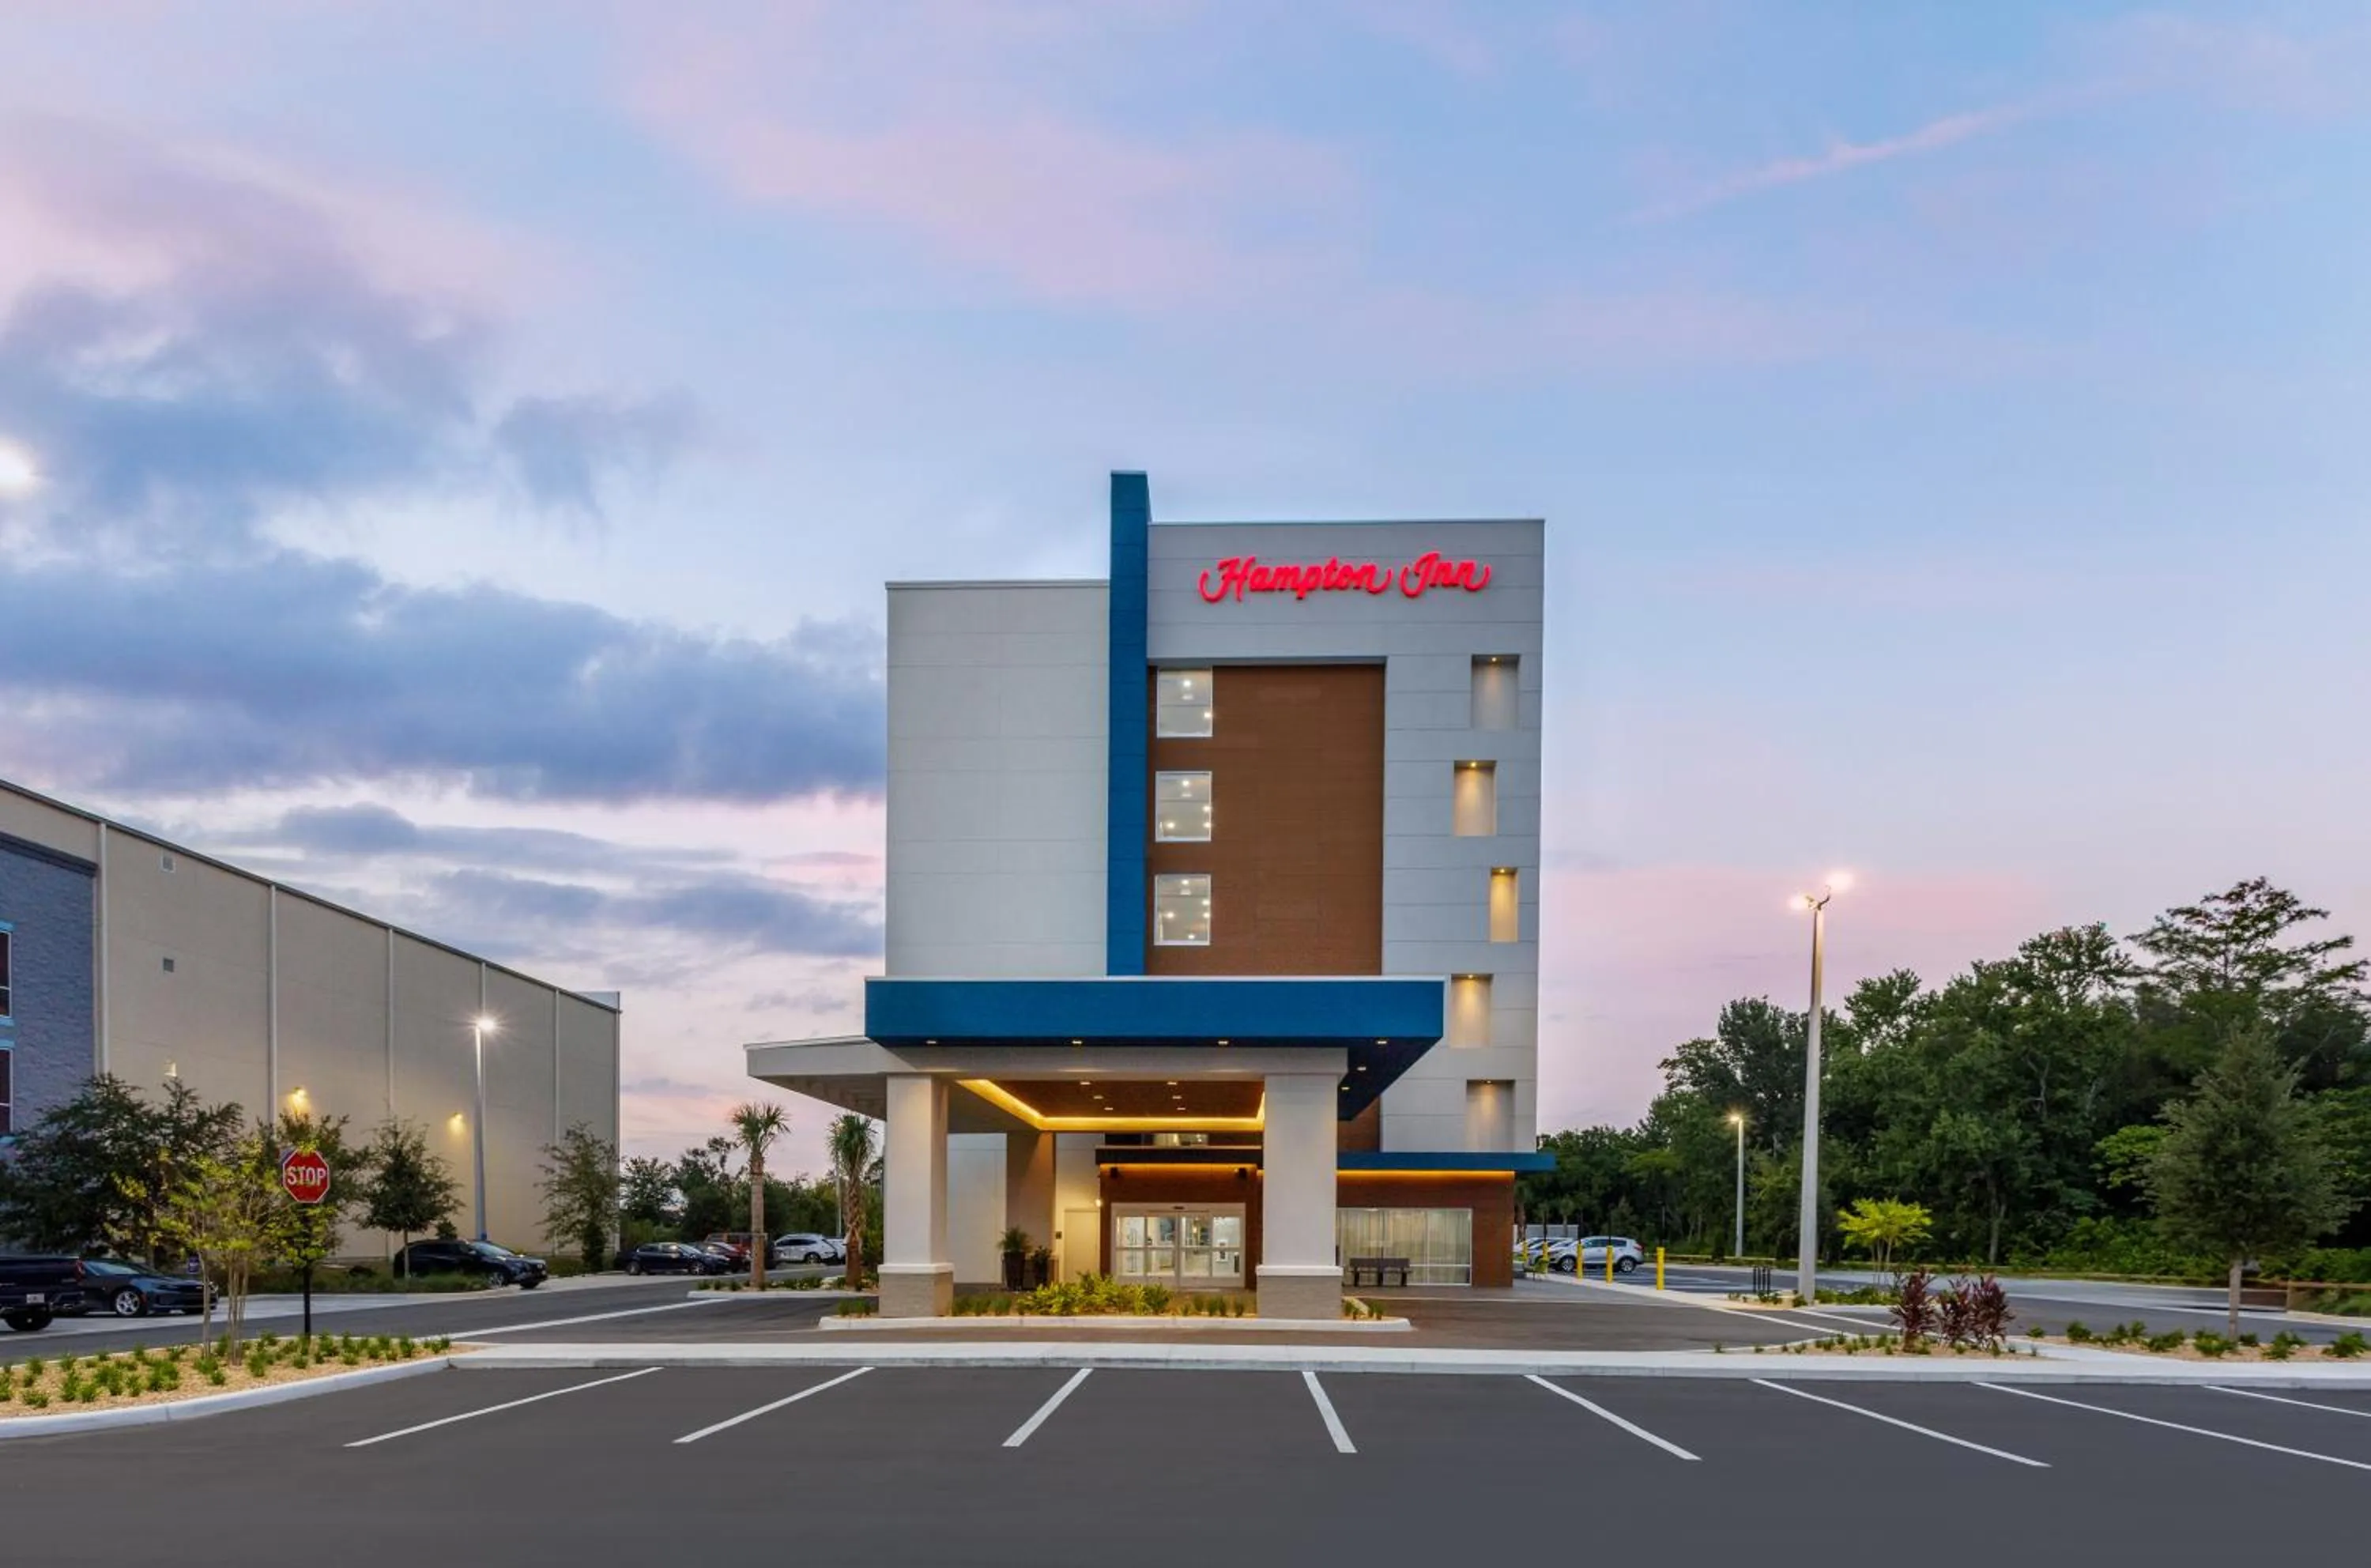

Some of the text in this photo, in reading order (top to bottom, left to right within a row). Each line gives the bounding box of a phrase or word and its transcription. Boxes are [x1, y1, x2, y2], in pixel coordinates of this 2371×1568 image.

[1199, 552, 1491, 602] Hampton Inn
[287, 1167, 326, 1186] STOP
